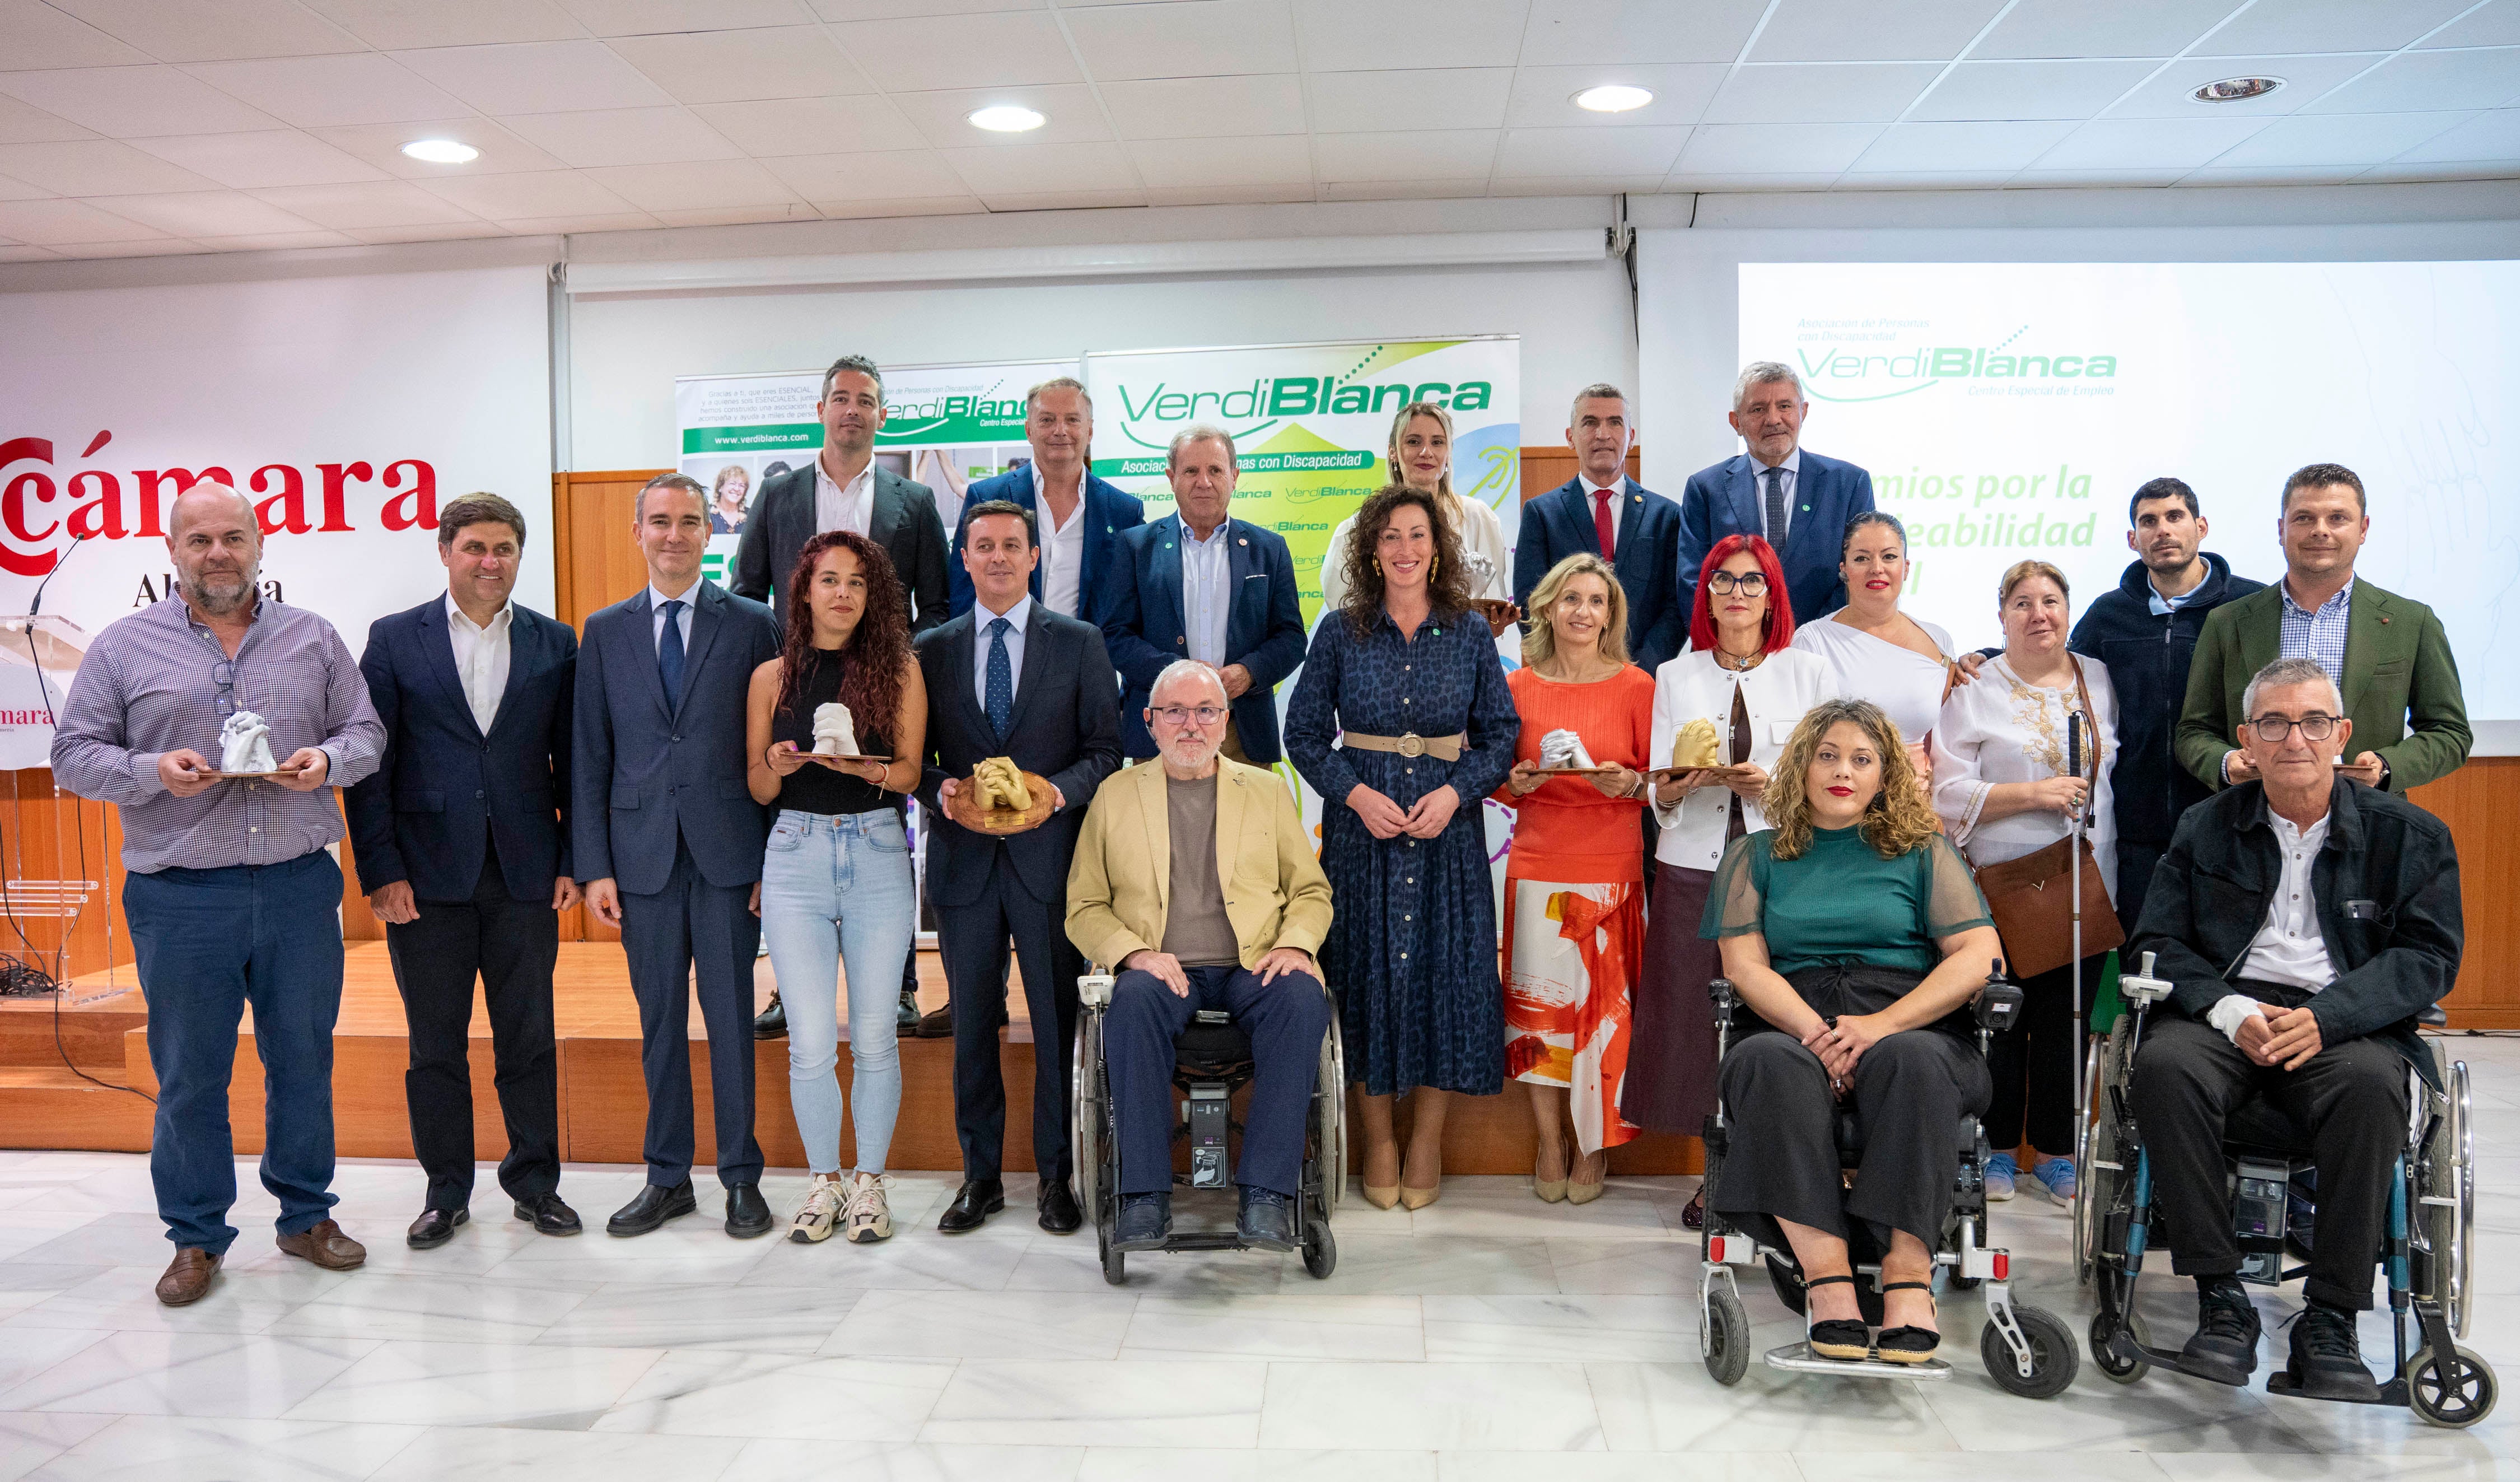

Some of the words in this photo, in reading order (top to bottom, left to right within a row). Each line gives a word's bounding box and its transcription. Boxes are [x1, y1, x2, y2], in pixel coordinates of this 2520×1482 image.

[1861, 318, 1875, 328] de
[1879, 318, 1930, 328] Personas
[1798, 332, 1819, 341] con
[1822, 331, 1896, 342] Discapacidad
[1797, 347, 2117, 378] VerdiBlanca
[945, 384, 983, 393] Discapacidad
[1968, 385, 2004, 396] Centro
[2008, 384, 2053, 397] Especial
[2056, 385, 2070, 395] de
[1118, 376, 1492, 422] VerdiBlanca
[980, 418, 1000, 427] Centro
[715, 434, 809, 444] www.verdiblanca.com
[1259, 457, 1280, 469] con
[1284, 453, 1362, 469] Discapacidad
[1973, 474, 2047, 508] por
[2056, 463, 2093, 500] la
